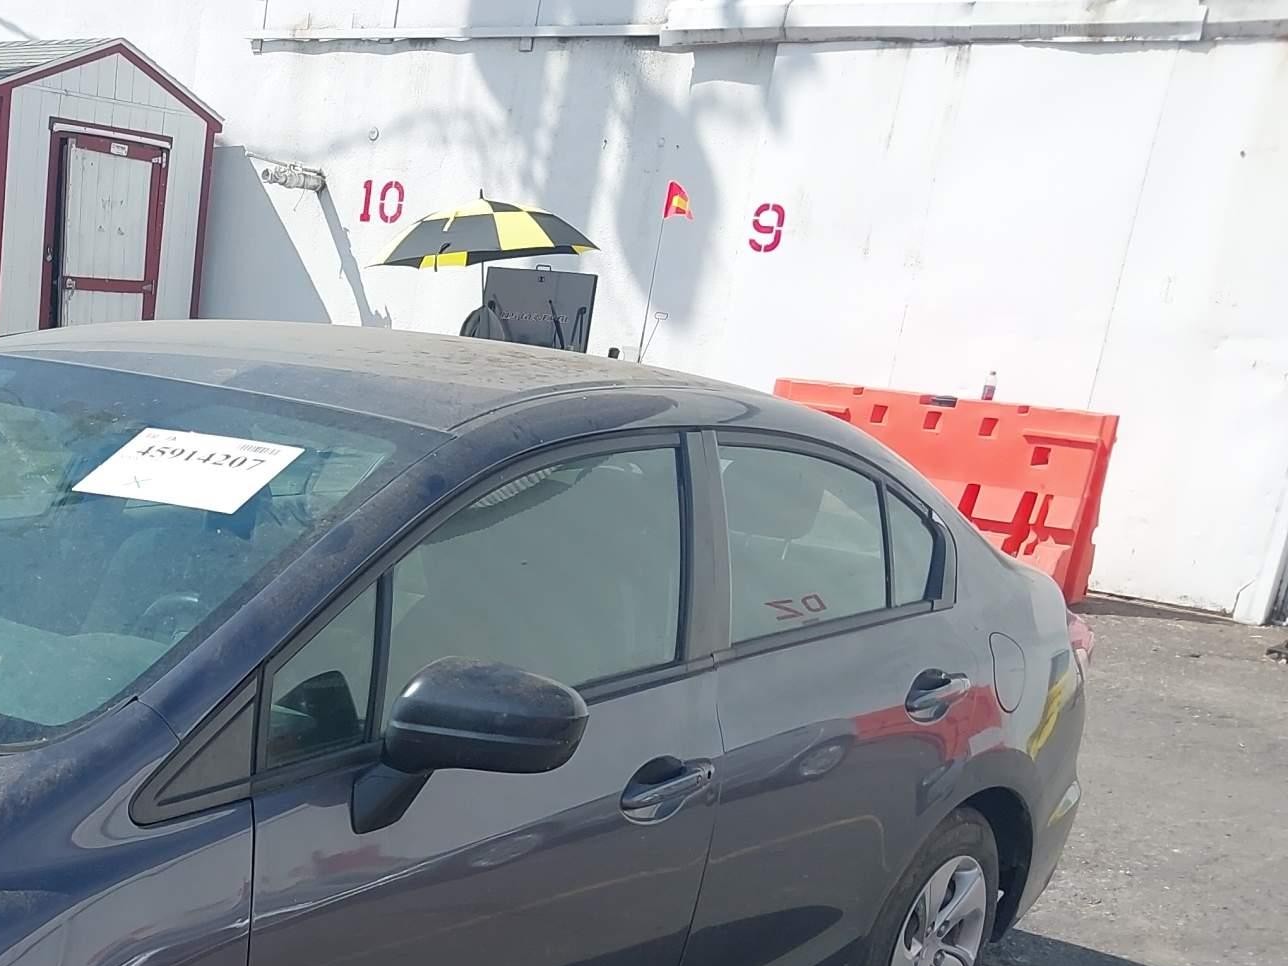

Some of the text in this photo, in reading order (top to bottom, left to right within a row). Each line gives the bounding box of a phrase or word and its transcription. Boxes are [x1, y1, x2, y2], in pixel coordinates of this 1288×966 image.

[358, 179, 406, 225] 10
[748, 202, 787, 253] 9
[135, 444, 266, 472] 45914207
